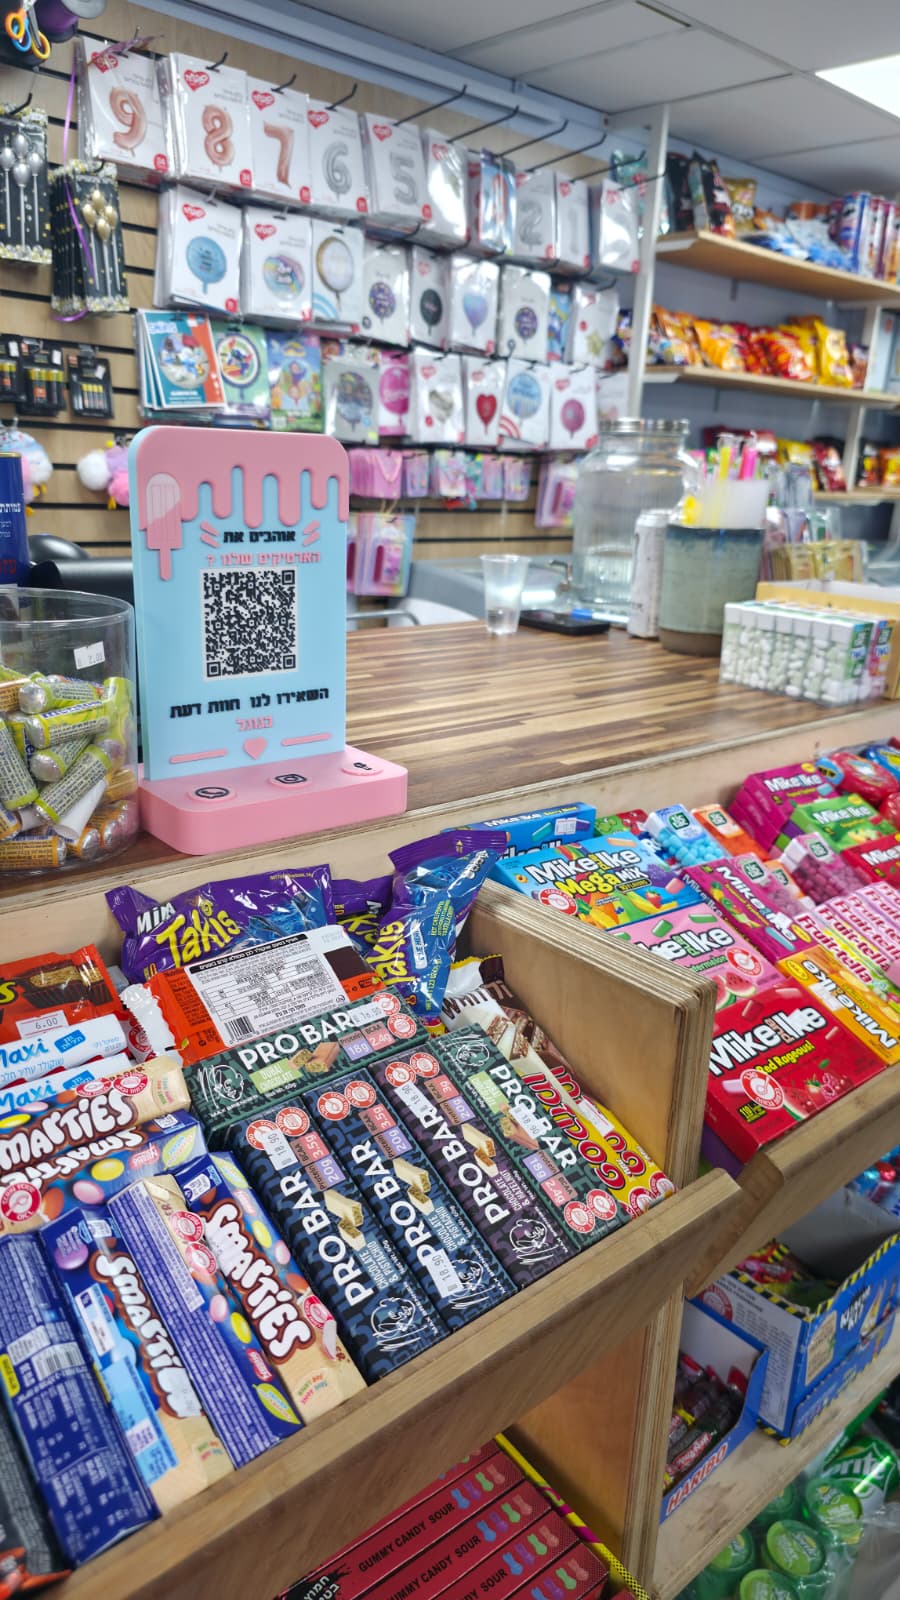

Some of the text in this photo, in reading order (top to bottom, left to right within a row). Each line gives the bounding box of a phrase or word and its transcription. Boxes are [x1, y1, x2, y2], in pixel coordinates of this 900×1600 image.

[223, 531, 296, 543] אוהבים את
[222, 553, 252, 566] שלנו
[257, 551, 320, 567] הארטיקים
[170, 688, 329, 719] השאירו לנו חוות דעת
[236, 715, 273, 731] בגוגל
[525, 856, 594, 884] Mike
[603, 849, 642, 868] Ike
[553, 871, 616, 897] Mega
[156, 899, 241, 969] Takis
[681, 928, 735, 953] Ike
[797, 915, 873, 984] Fruit-tella
[35, 1017, 59, 1031] 6.00
[837, 994, 898, 1049] Mike
[238, 1033, 299, 1071] PRO
[299, 1011, 353, 1045] BAR
[349, 1042, 369, 1056] 18g
[709, 1023, 782, 1077] Mike
[756, 1040, 816, 1075] Red Rageous!
[373, 1107, 390, 1128] 3.5g
[453, 1100, 470, 1117] 20g
[489, 1064, 577, 1169] PRO BAR
[305, 1135, 324, 1158] 3.5g
[388, 1130, 407, 1150] 20g
[308, 1165, 328, 1191] Protein
[321, 1158, 340, 1183] 20g
[420, 1106, 510, 1225] PRO BAR
[530, 1156, 546, 1179] 18g
[351, 1140, 438, 1268] PRO BAR
[494, 1178, 522, 1212] CHOCOLATE
[280, 1171, 374, 1306] PRO BAR
[429, 1214, 458, 1251] CHOCOLATE
[435, 1206, 463, 1240] PISTACHIO
[359, 1251, 389, 1290] CHOCOLATE
[367, 1241, 395, 1275] PISTACHIO
[432, 1254, 450, 1281] 18.90
[666, 1442, 728, 1516] HARIBO
[358, 1502, 455, 1573] GUMMY CANDY SOUR
[420, 1555, 453, 1584] CANDY
[454, 1535, 482, 1559] SOUR
[480, 1568, 508, 1593] SOUR
